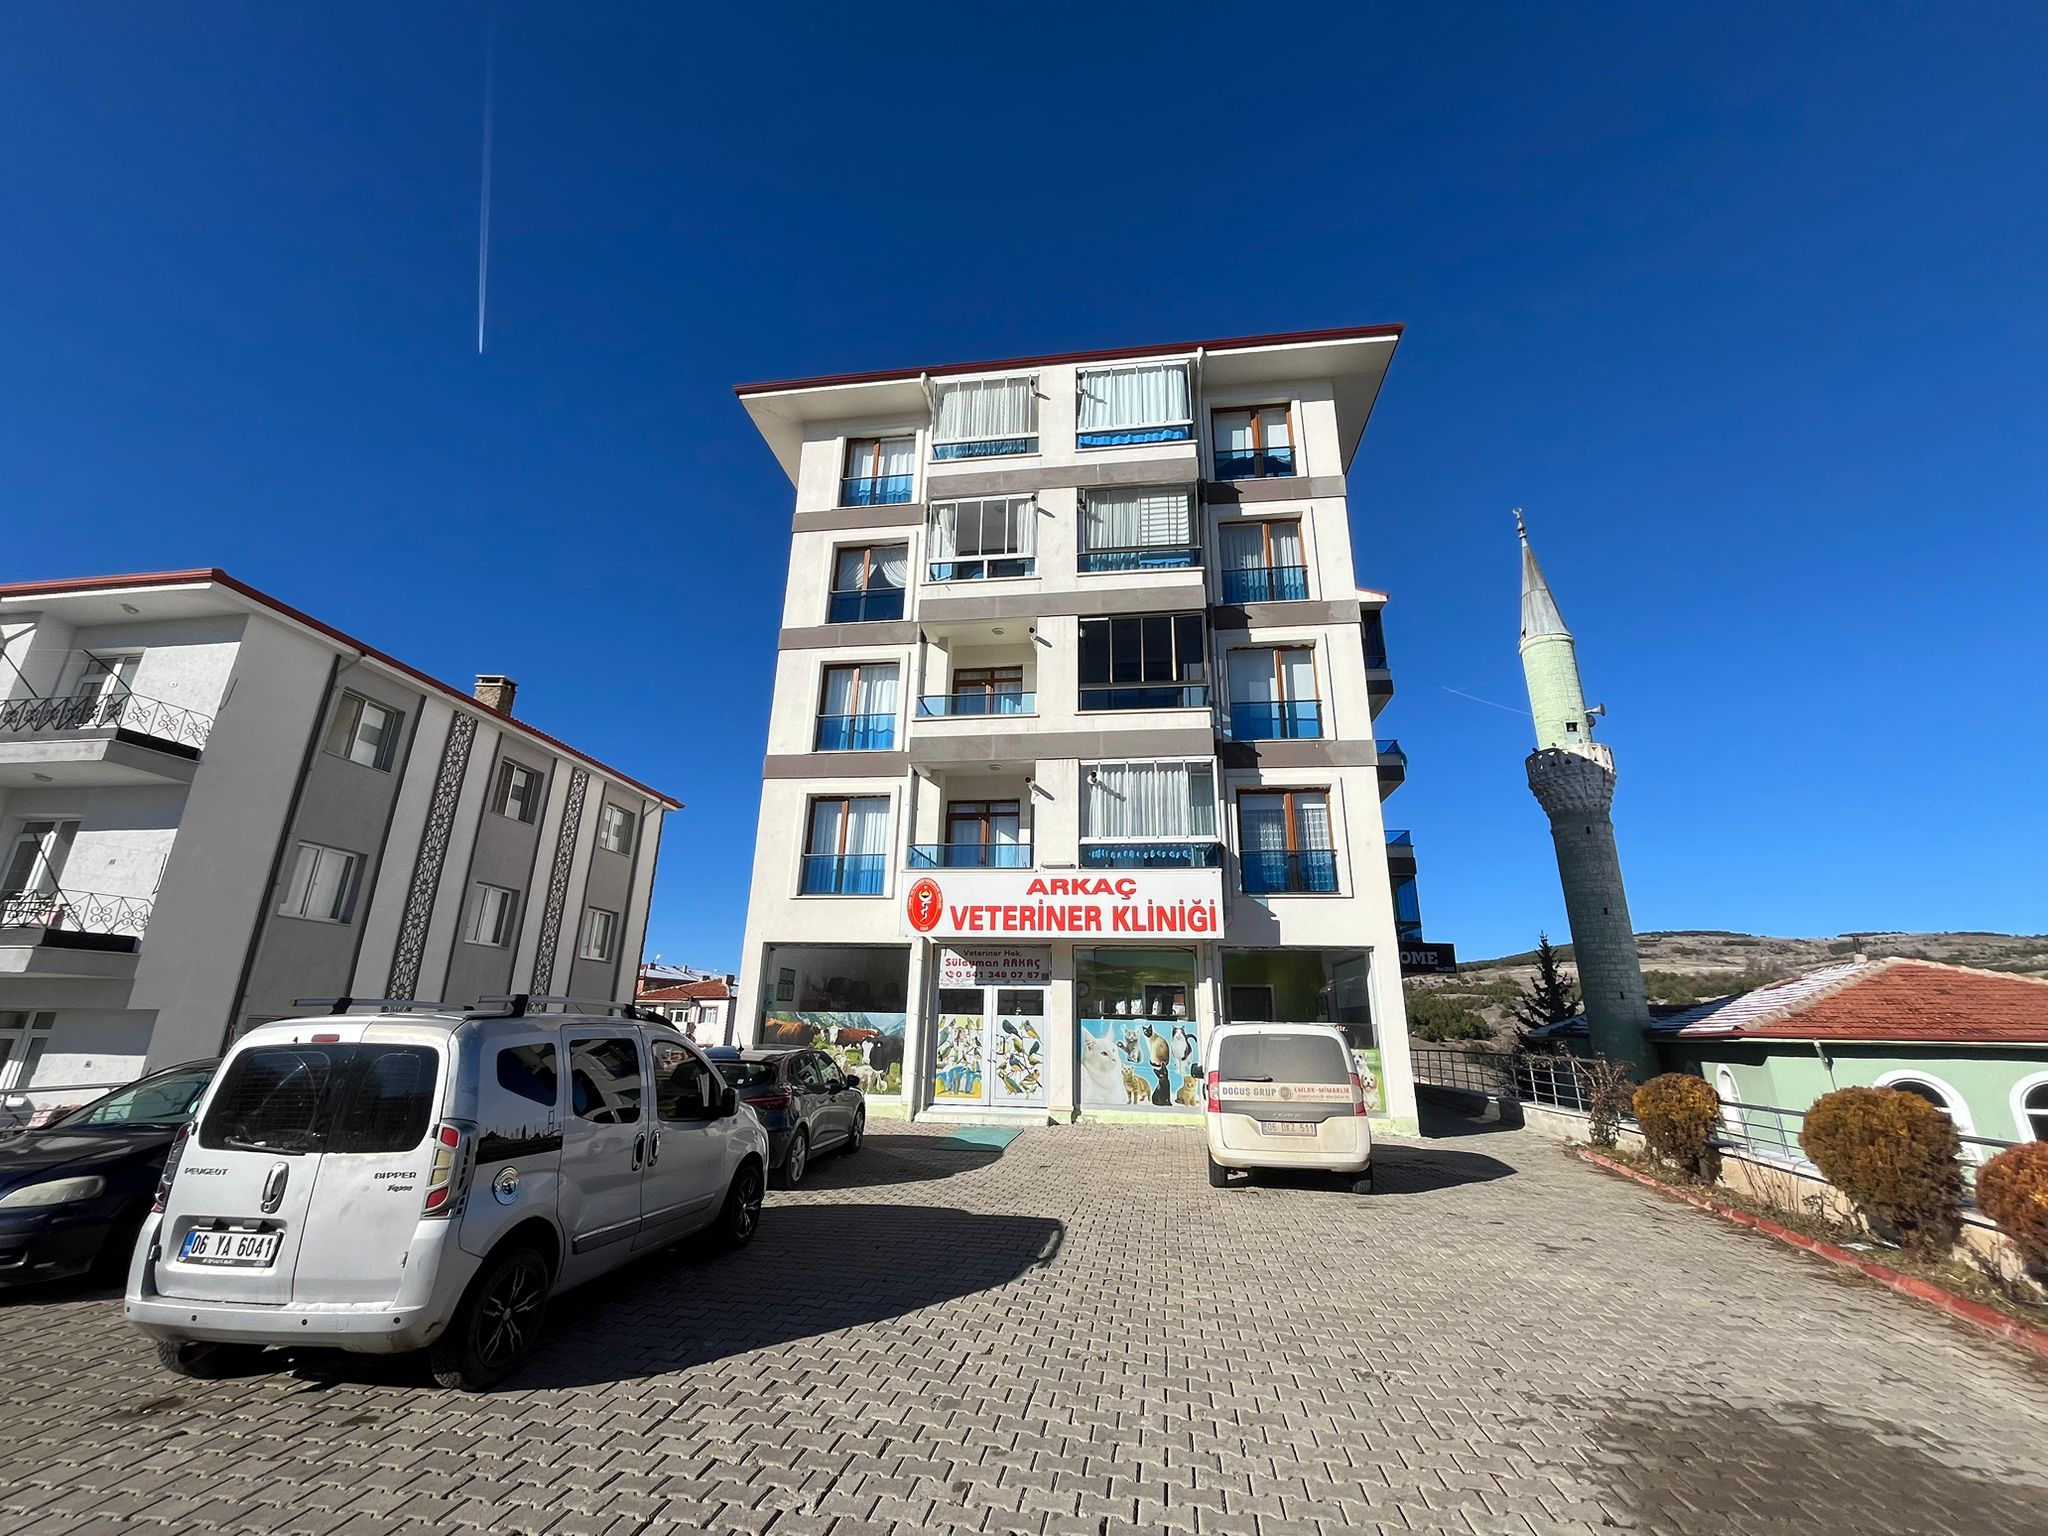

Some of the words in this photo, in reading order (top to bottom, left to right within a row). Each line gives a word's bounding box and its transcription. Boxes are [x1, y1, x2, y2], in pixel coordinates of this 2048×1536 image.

[1026, 878, 1137, 900] ARKAÇ
[949, 899, 1101, 932] VETERİNER
[1112, 899, 1217, 932] KLİNİĞİ
[963, 949, 1001, 957] Veteriner
[1010, 970, 1023, 978] 07
[184, 1167, 228, 1176] PEUGEOT
[374, 1171, 417, 1179] BIPPER
[191, 1234, 209, 1255] 06
[214, 1235, 232, 1257] YA
[237, 1236, 274, 1259] 6041
